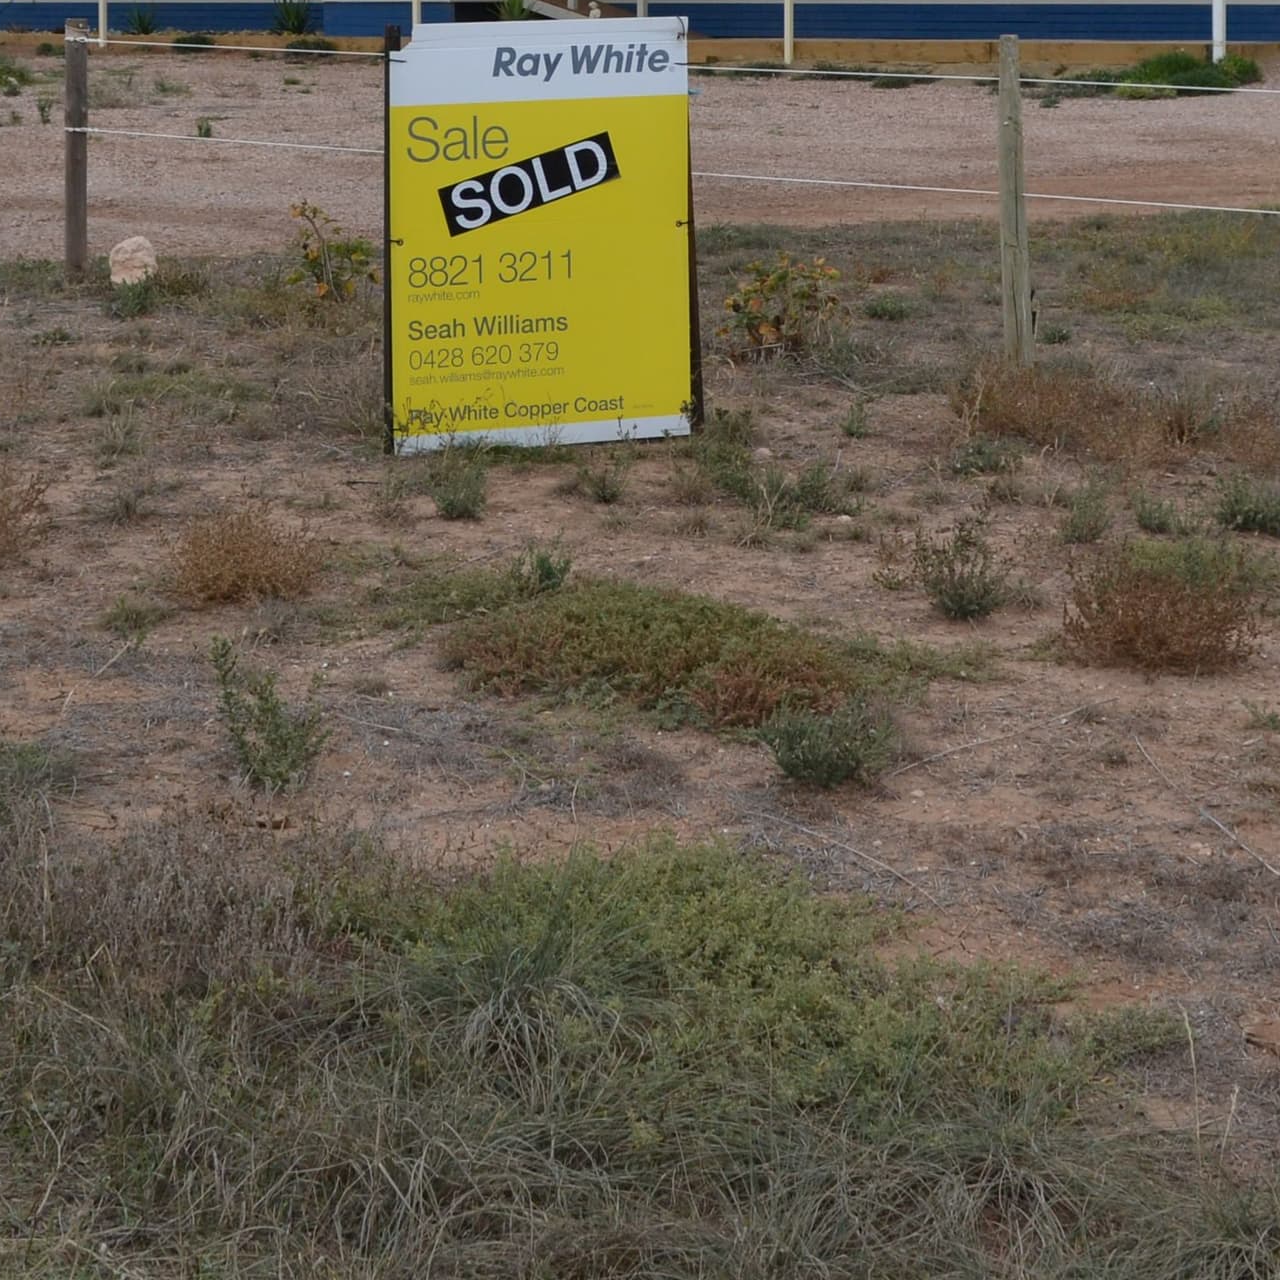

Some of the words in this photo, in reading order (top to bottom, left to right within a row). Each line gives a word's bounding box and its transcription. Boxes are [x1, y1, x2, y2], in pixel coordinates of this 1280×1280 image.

[492, 46, 562, 82] Ray
[570, 43, 669, 75] White
[407, 115, 508, 163] Sale
[450, 139, 608, 229] SOLD
[408, 253, 483, 288] 8821
[498, 249, 572, 283] 3211
[408, 289, 480, 304] raywhite.com
[408, 318, 466, 341] Seah
[473, 314, 568, 337] Williams
[409, 347, 464, 370] 0428
[471, 344, 512, 367] 620
[519, 341, 559, 363] 379
[408, 409, 444, 427] Ray
[449, 405, 499, 422] White
[504, 400, 569, 418] Copper
[574, 395, 624, 414] Coast
